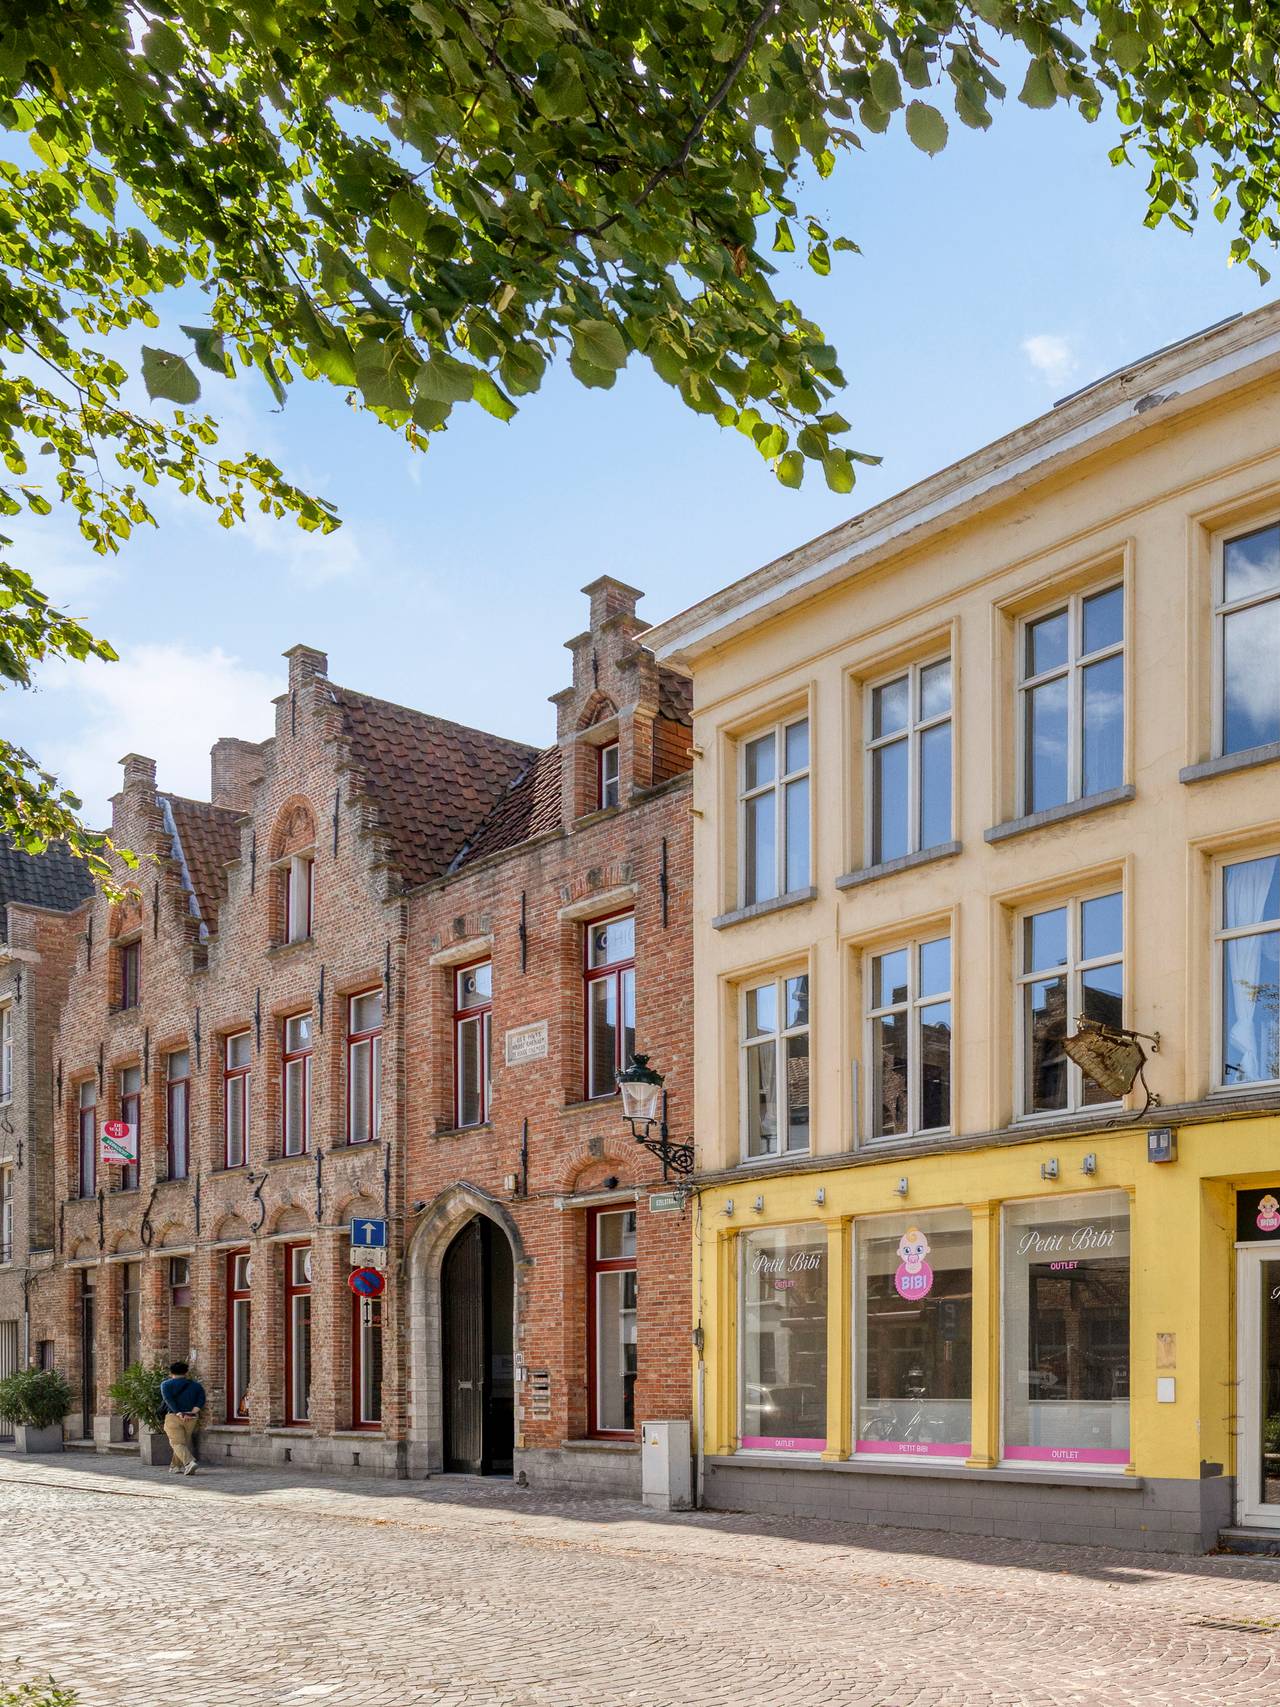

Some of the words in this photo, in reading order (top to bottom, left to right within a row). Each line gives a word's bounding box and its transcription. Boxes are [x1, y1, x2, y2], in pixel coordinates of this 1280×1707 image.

[1016, 1231, 1065, 1255] Petit
[1068, 1225, 1115, 1251] Bibi
[751, 1255, 785, 1275] Petit
[787, 1251, 821, 1272] Bibi
[1050, 1261, 1079, 1270] OUTLET
[901, 1275, 927, 1290] BIBI
[899, 1444, 915, 1452] PETIT
[1051, 1450, 1079, 1459] OUTLET
